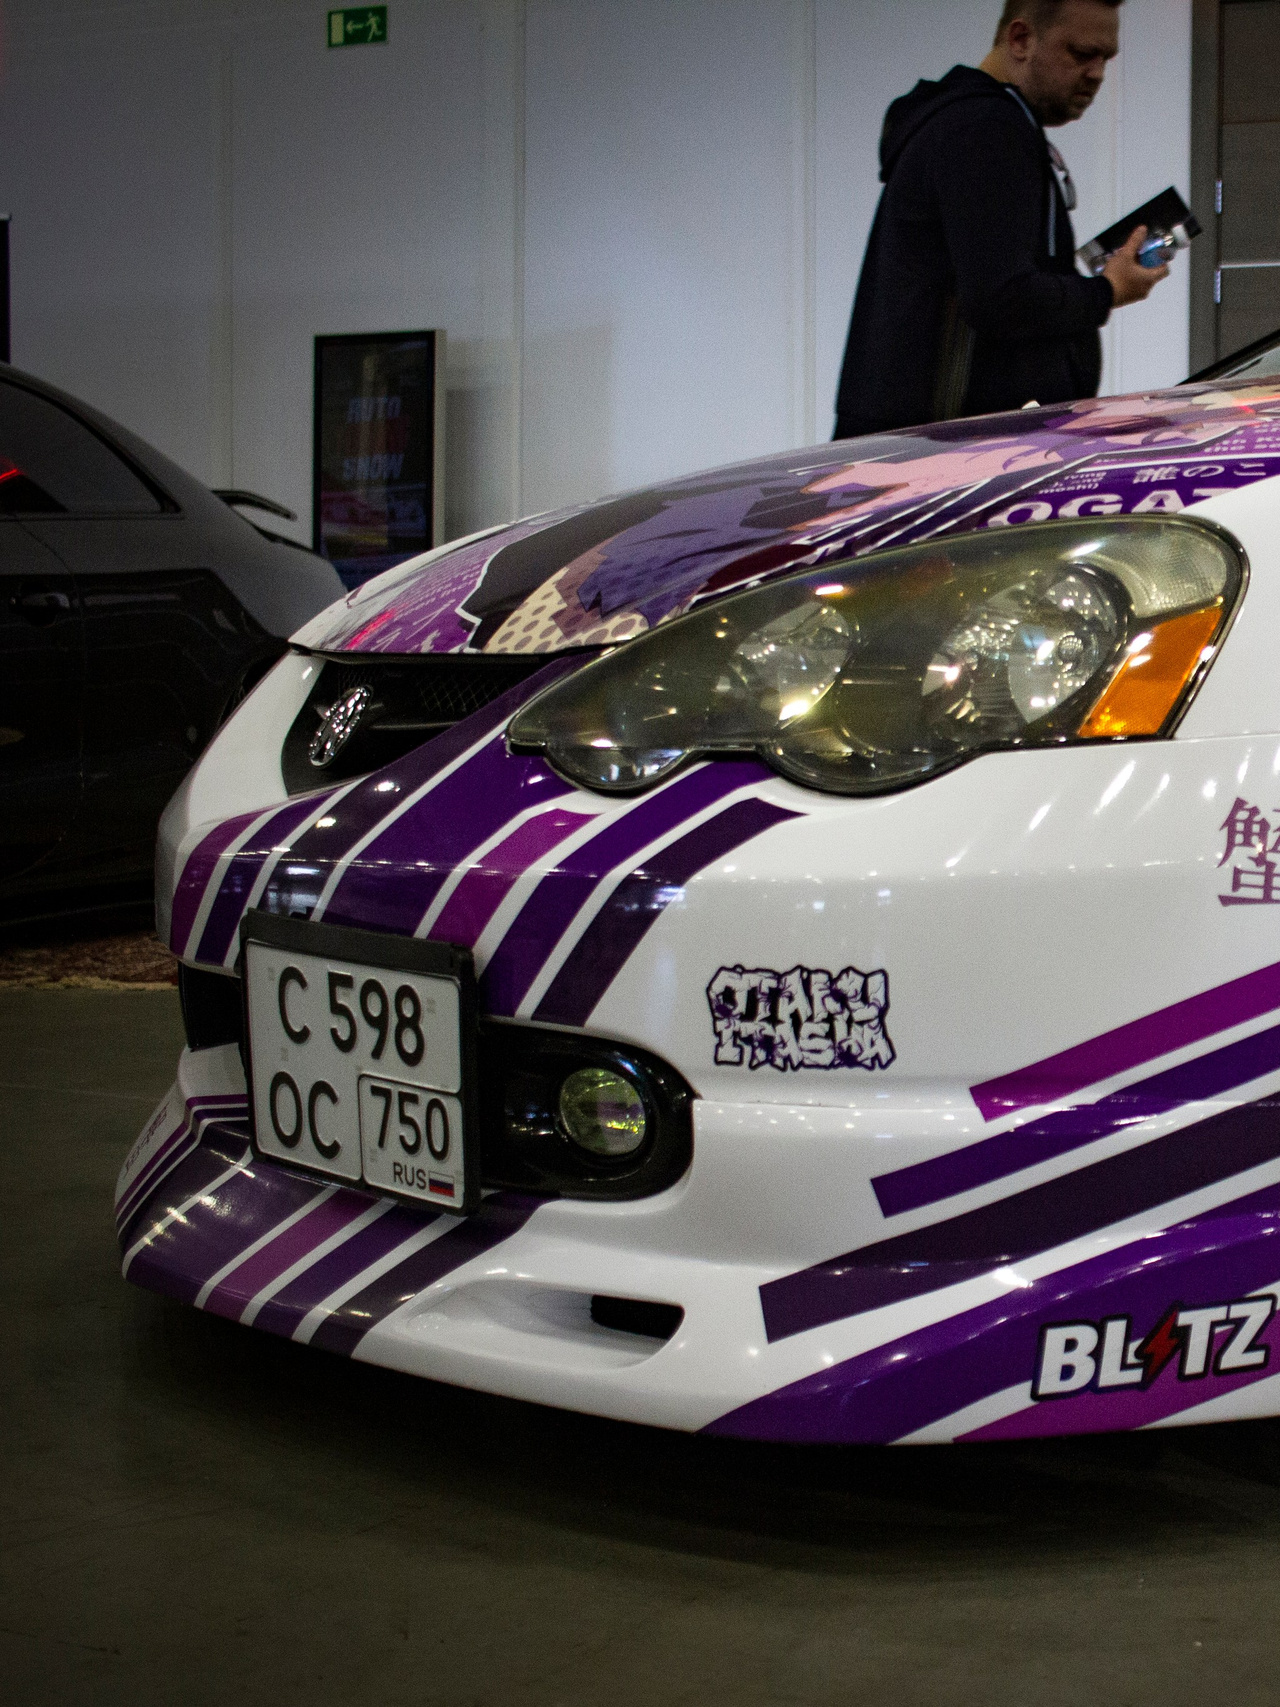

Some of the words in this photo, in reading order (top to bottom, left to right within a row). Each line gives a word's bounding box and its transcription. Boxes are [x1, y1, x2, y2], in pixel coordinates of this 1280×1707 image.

[278, 965, 311, 1045] C
[327, 971, 426, 1068] 598
[269, 1070, 342, 1160] OC
[370, 1084, 450, 1161] 750
[392, 1161, 427, 1191] RUS
[1032, 1294, 1276, 1399] BLITZ
